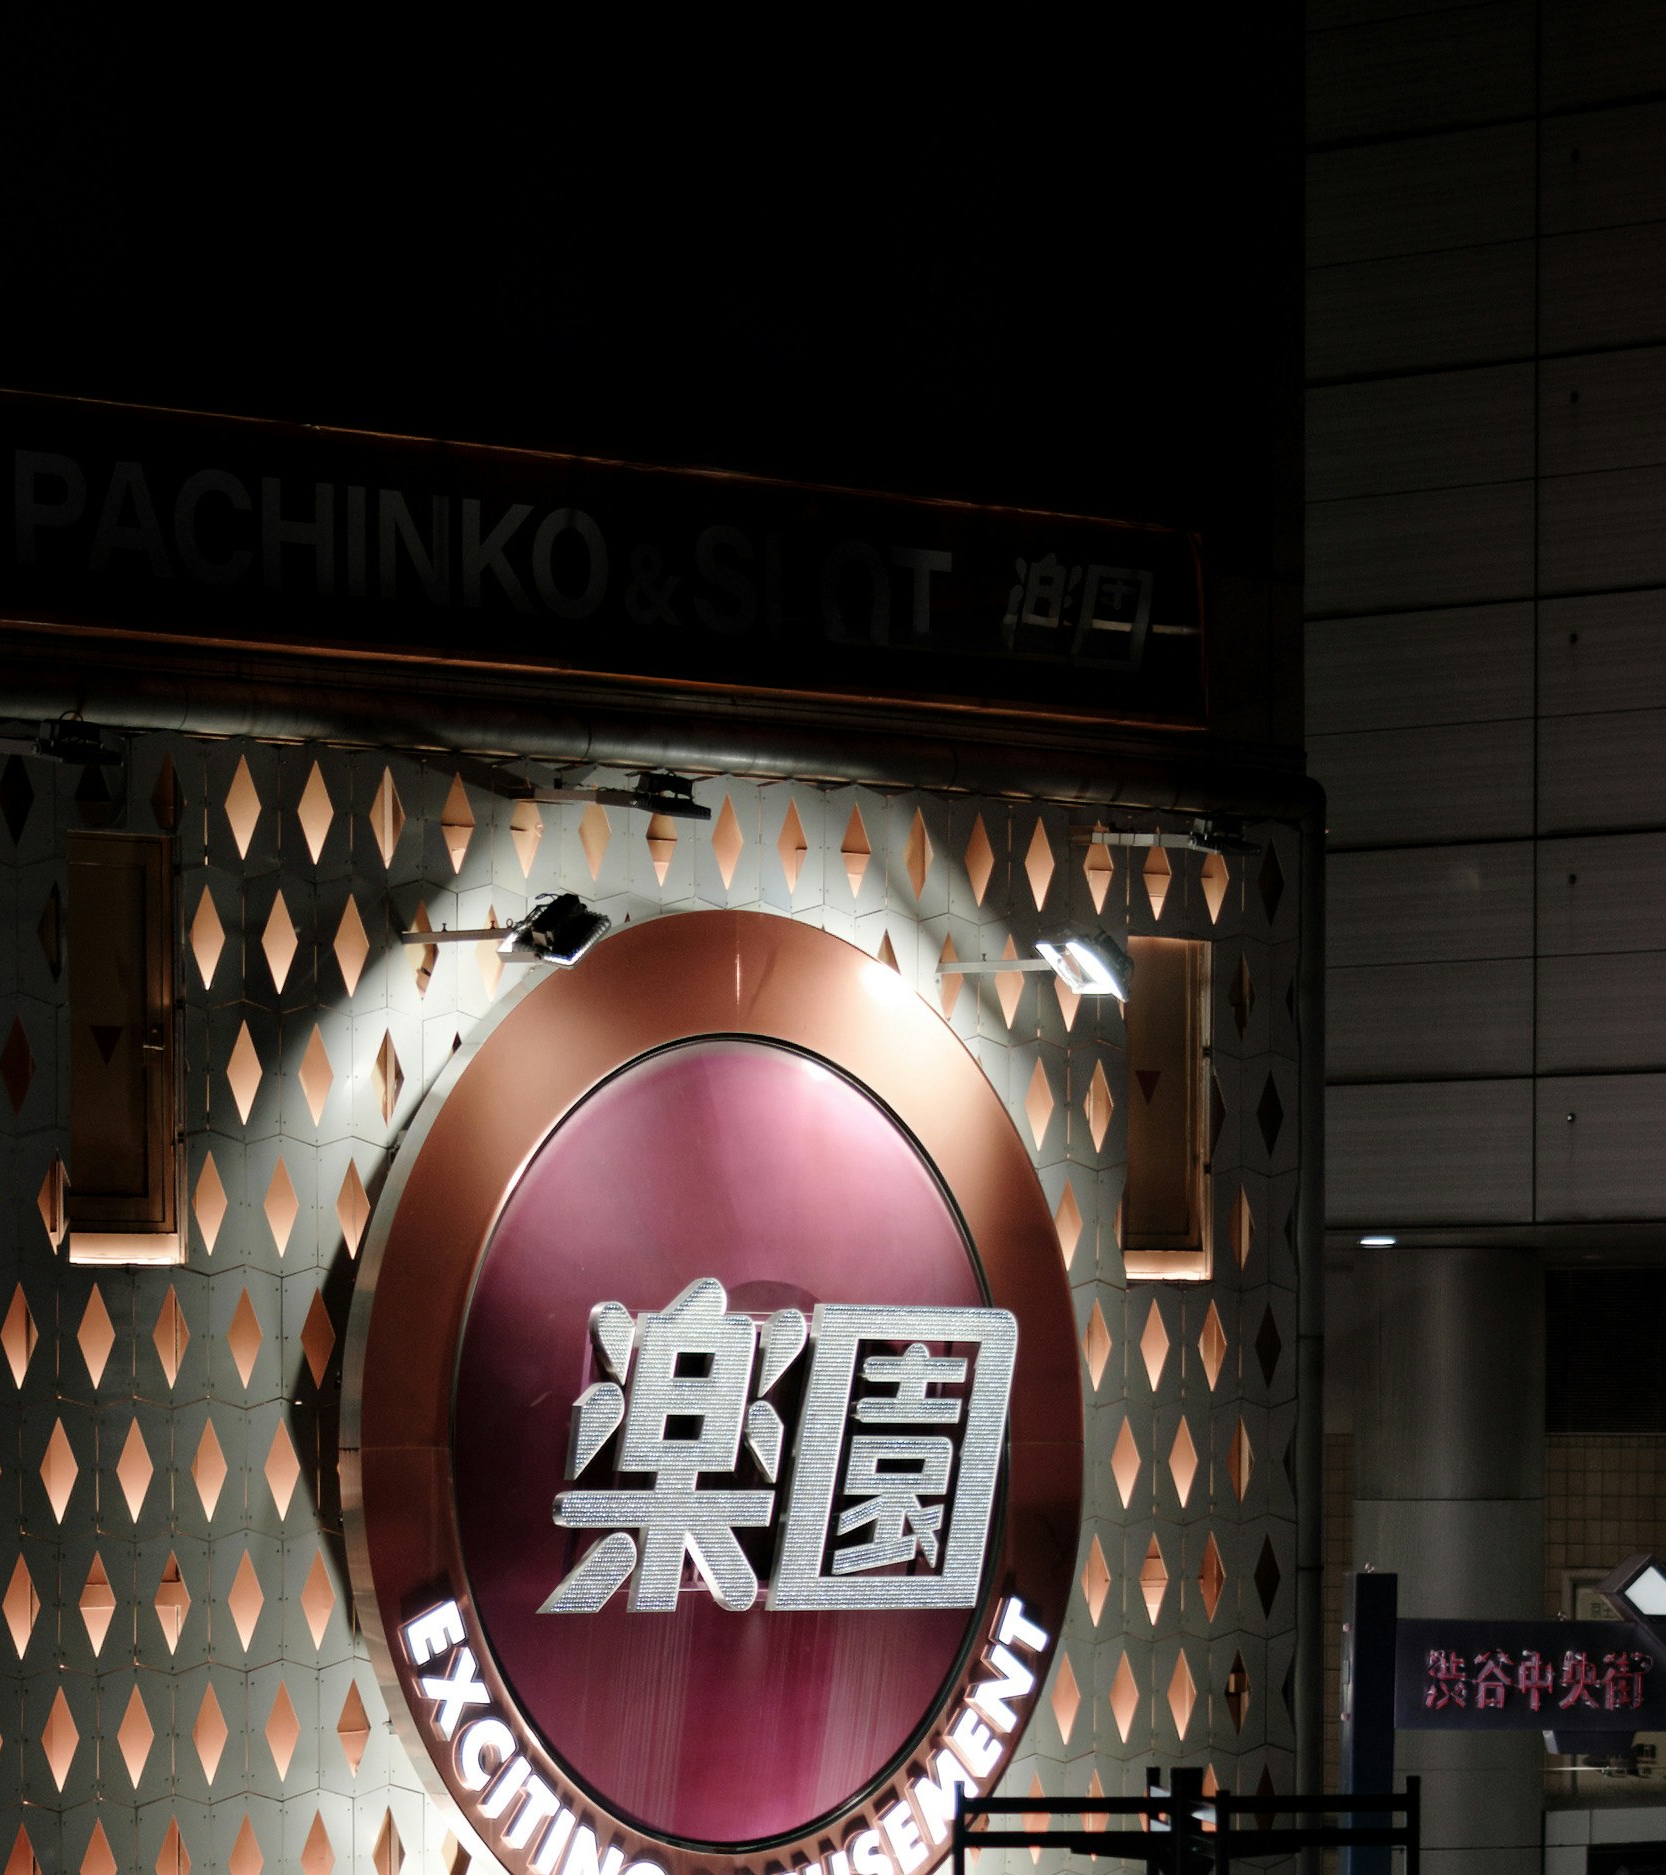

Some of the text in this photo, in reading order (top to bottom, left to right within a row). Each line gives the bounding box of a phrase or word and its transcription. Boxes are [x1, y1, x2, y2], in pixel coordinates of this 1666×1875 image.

[12, 446, 612, 622] PACHINKO
[536, 1277, 1019, 1614] 楽園
[1424, 1648, 1650, 1712] 渋谷中央街
